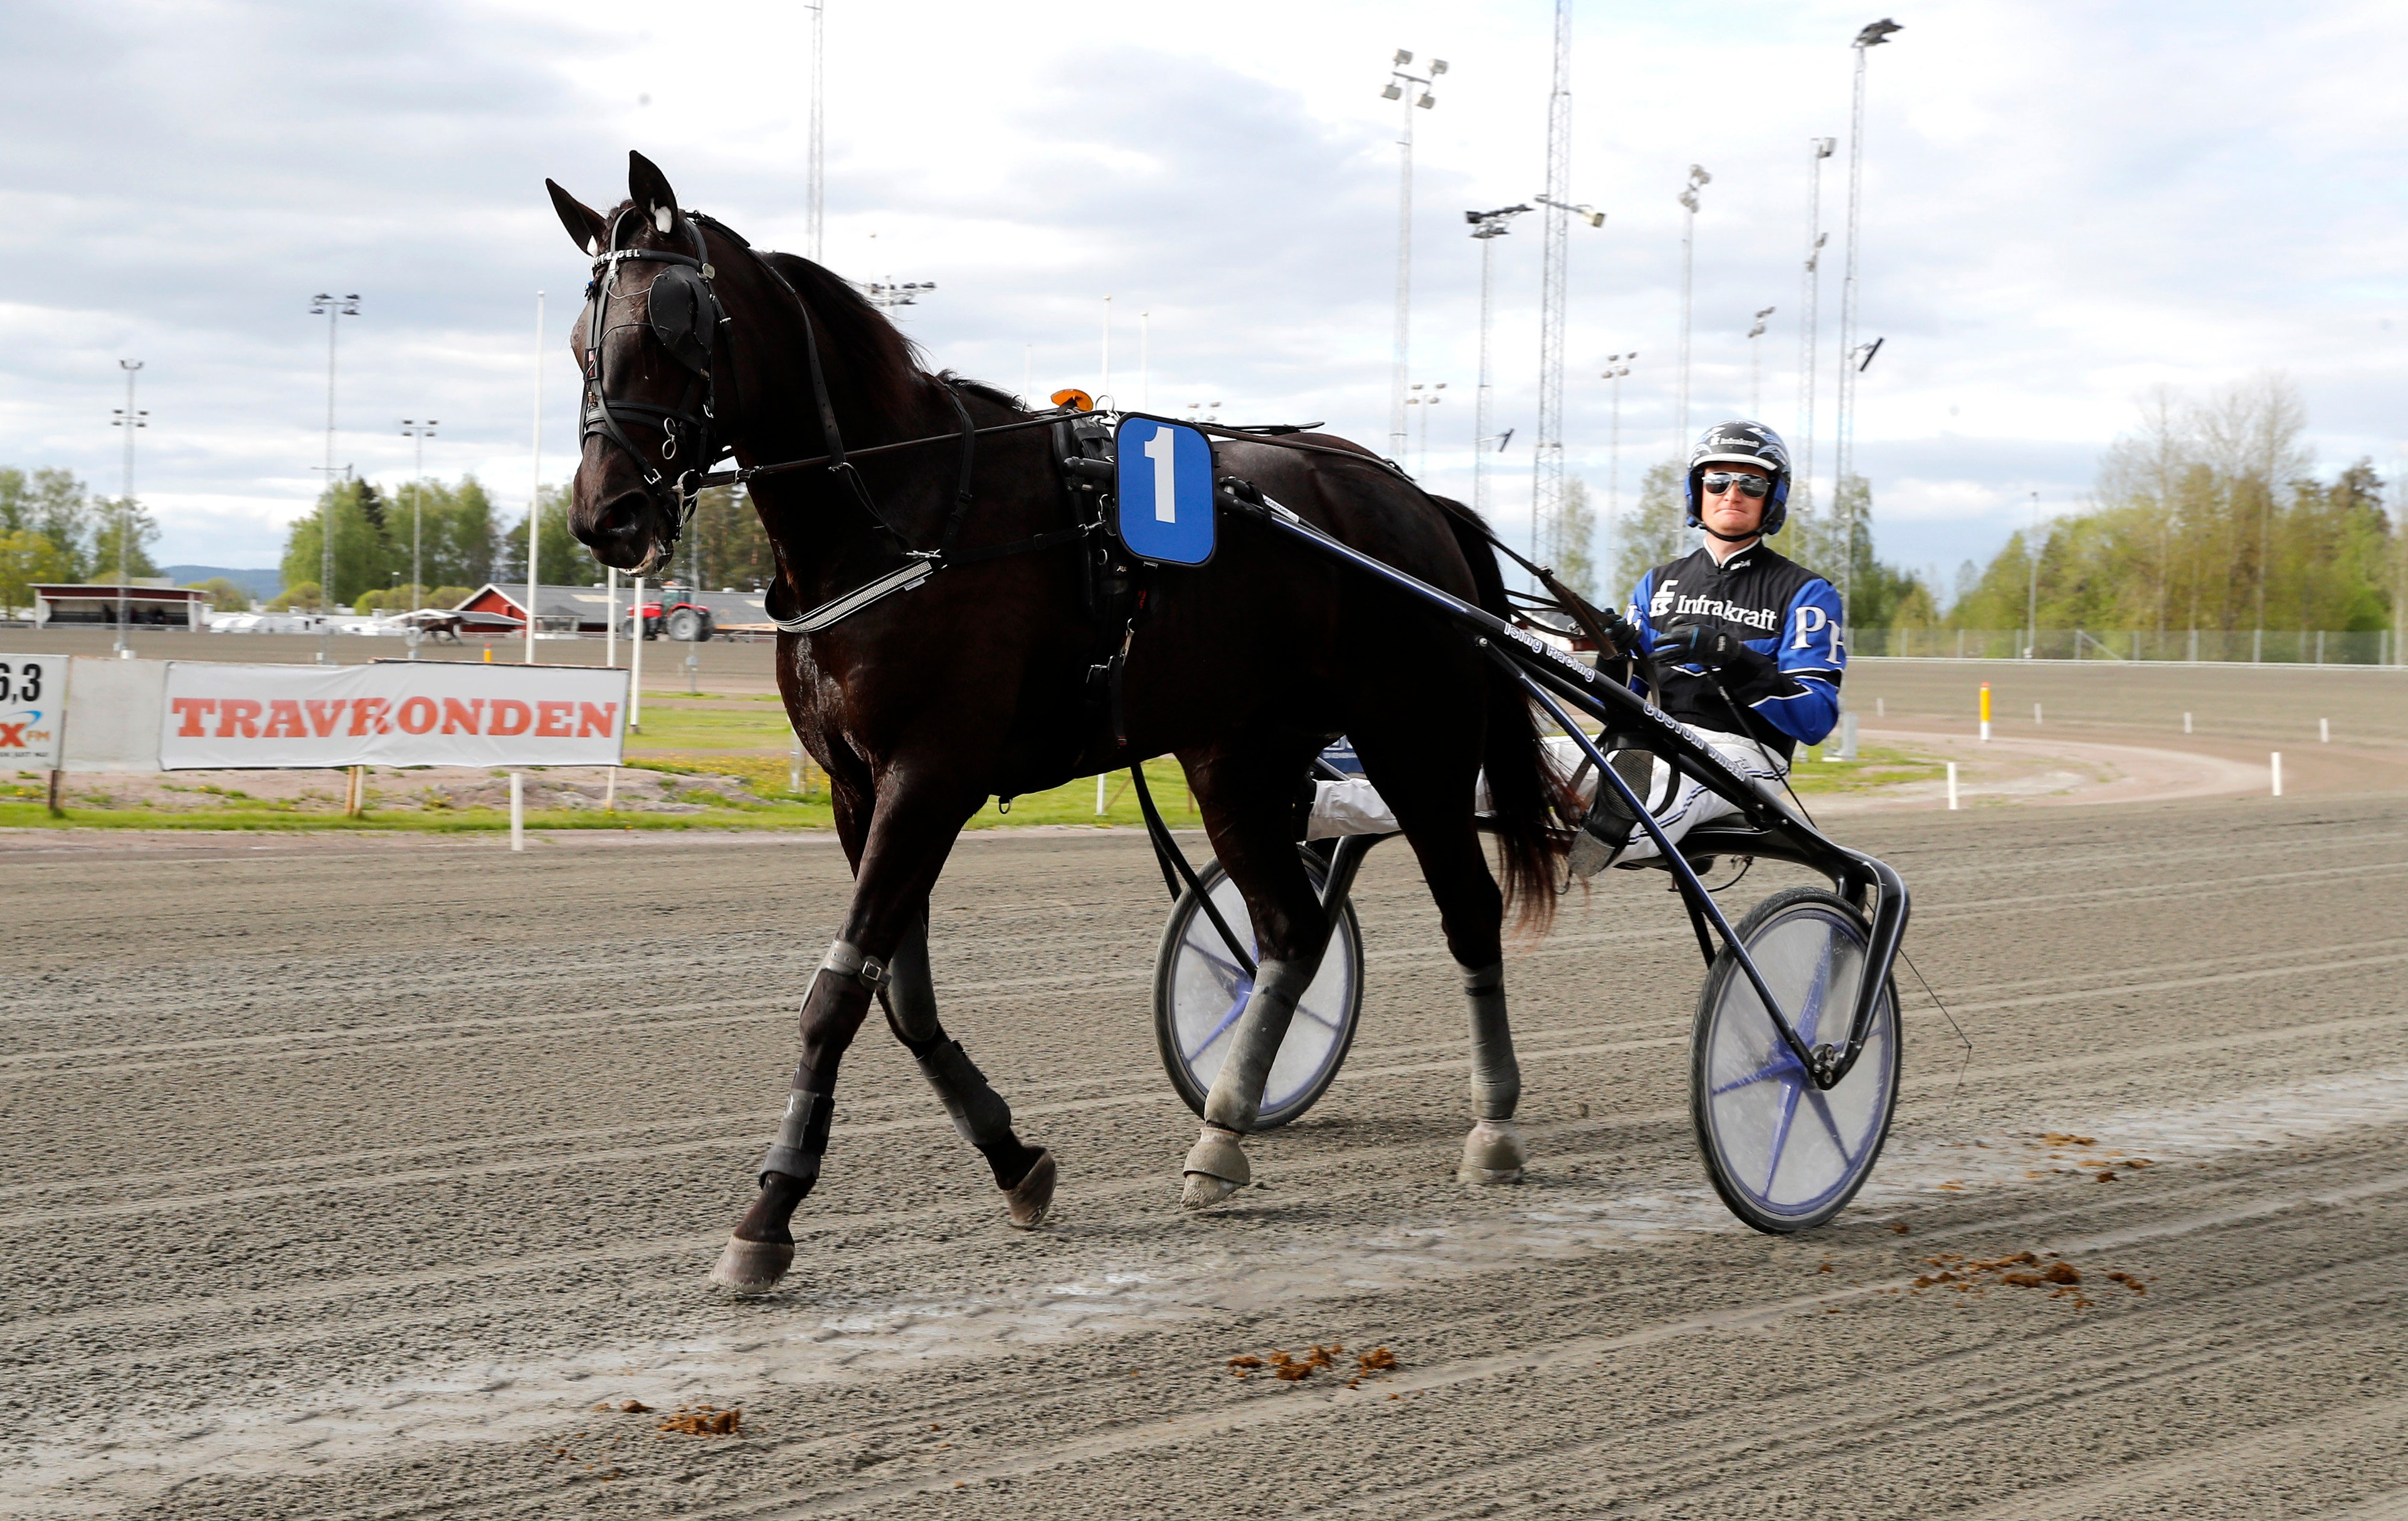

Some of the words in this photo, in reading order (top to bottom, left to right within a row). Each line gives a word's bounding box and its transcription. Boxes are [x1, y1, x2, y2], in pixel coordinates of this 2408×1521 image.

[1144, 427, 1176, 524] 1
[1676, 595, 1777, 631] Infrakraft
[1546, 644, 1595, 682] Racing
[27, 730, 50, 742] FM
[172, 697, 618, 739] TRAVRONDEN
[1643, 701, 1705, 750] CUSTOM
